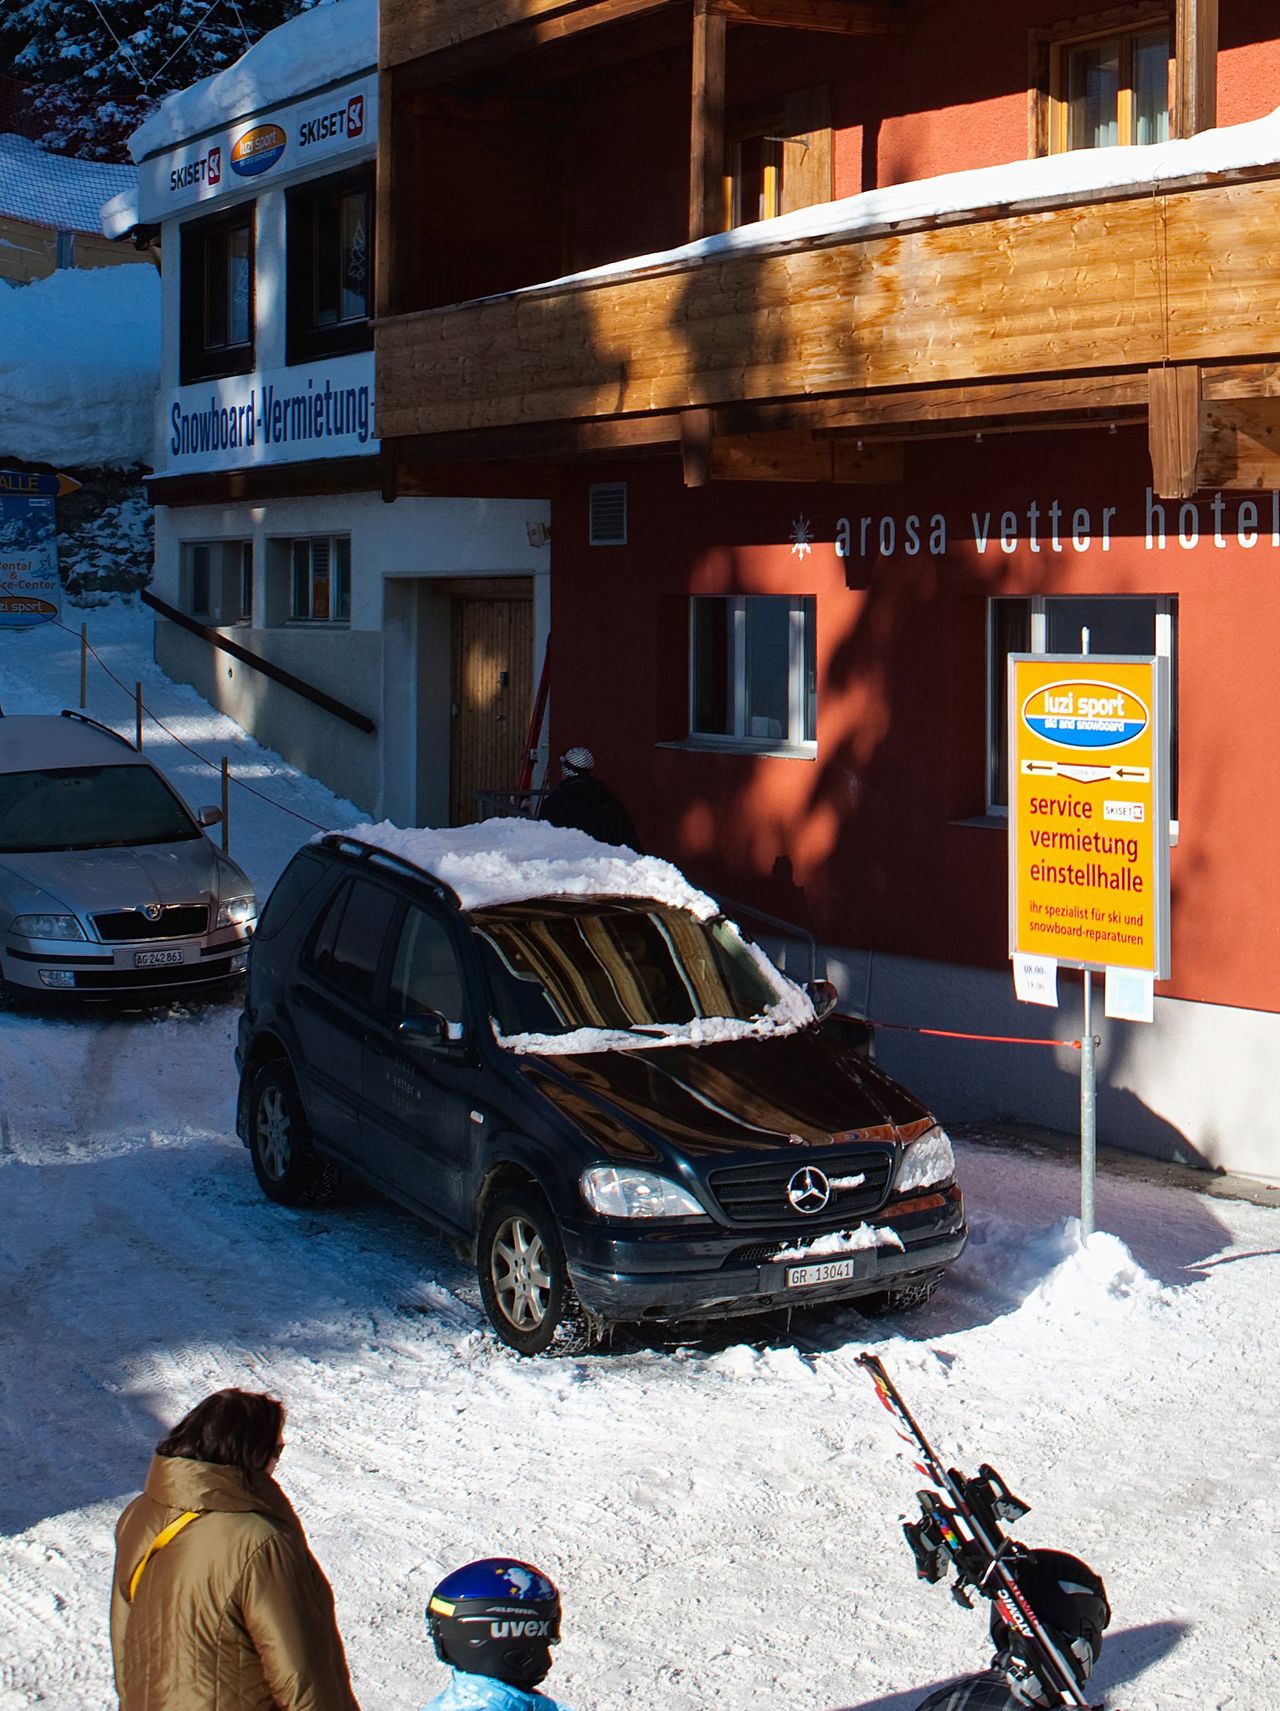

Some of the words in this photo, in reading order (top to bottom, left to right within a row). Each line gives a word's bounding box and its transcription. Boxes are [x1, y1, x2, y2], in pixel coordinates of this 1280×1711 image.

[299, 109, 347, 146] SKISET
[171, 159, 207, 191] SKISET
[834, 512, 947, 557] arosa
[971, 499, 1117, 554] vetter
[1146, 488, 1280, 550] hotel
[0, 560, 31, 571] ental
[0, 580, 56, 590] ce-Center
[11, 601, 42, 615] sport
[1044, 691, 1073, 714] luzi
[1077, 693, 1125, 719] sport
[1030, 794, 1093, 819] service
[1030, 828, 1139, 863] vermietung
[1030, 859, 1143, 893] einstellhalle
[1029, 901, 1042, 913] ihr
[1044, 903, 1088, 920] spezialist
[1091, 907, 1106, 922] für
[1107, 910, 1122, 925] ski
[1124, 914, 1143, 927] und
[1029, 920, 1144, 946] snowboard-reparaturen
[997, 1589, 1034, 1637] ATOMIC
[490, 1620, 550, 1639] uvex
